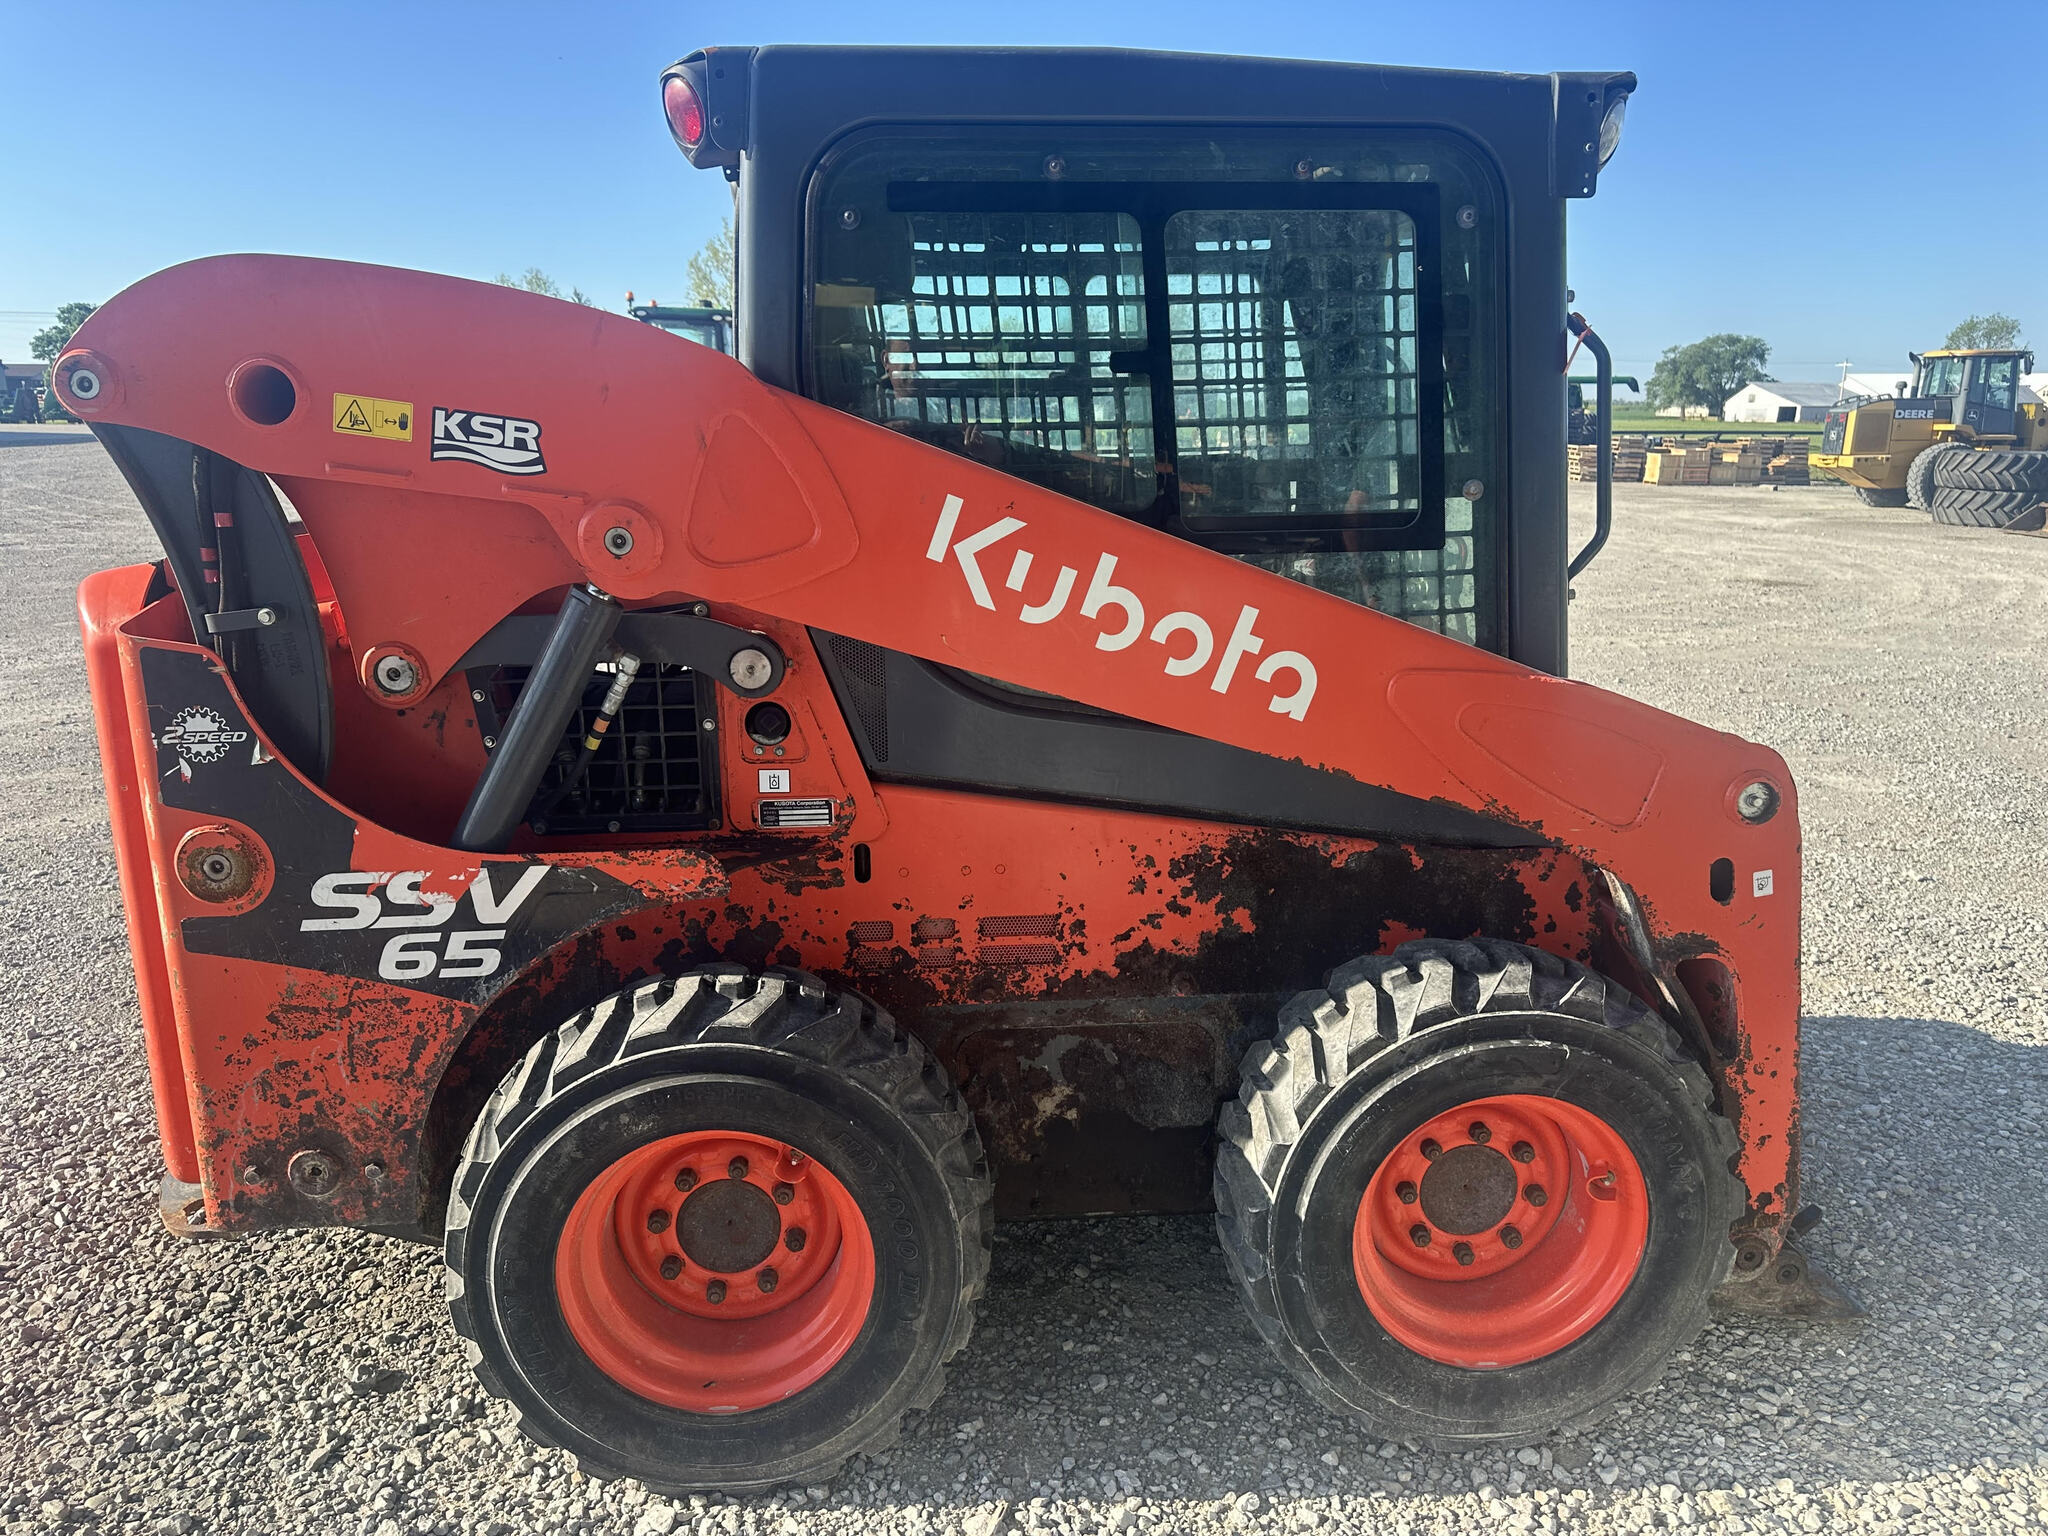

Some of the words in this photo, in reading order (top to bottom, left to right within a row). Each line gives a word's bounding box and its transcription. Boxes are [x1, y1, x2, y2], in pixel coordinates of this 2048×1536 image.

[434, 409, 539, 451] KSR
[1895, 409, 1934, 418] DEERE
[926, 494, 1317, 722] Kubota
[300, 865, 551, 931] SSV
[378, 929, 506, 980] 65
